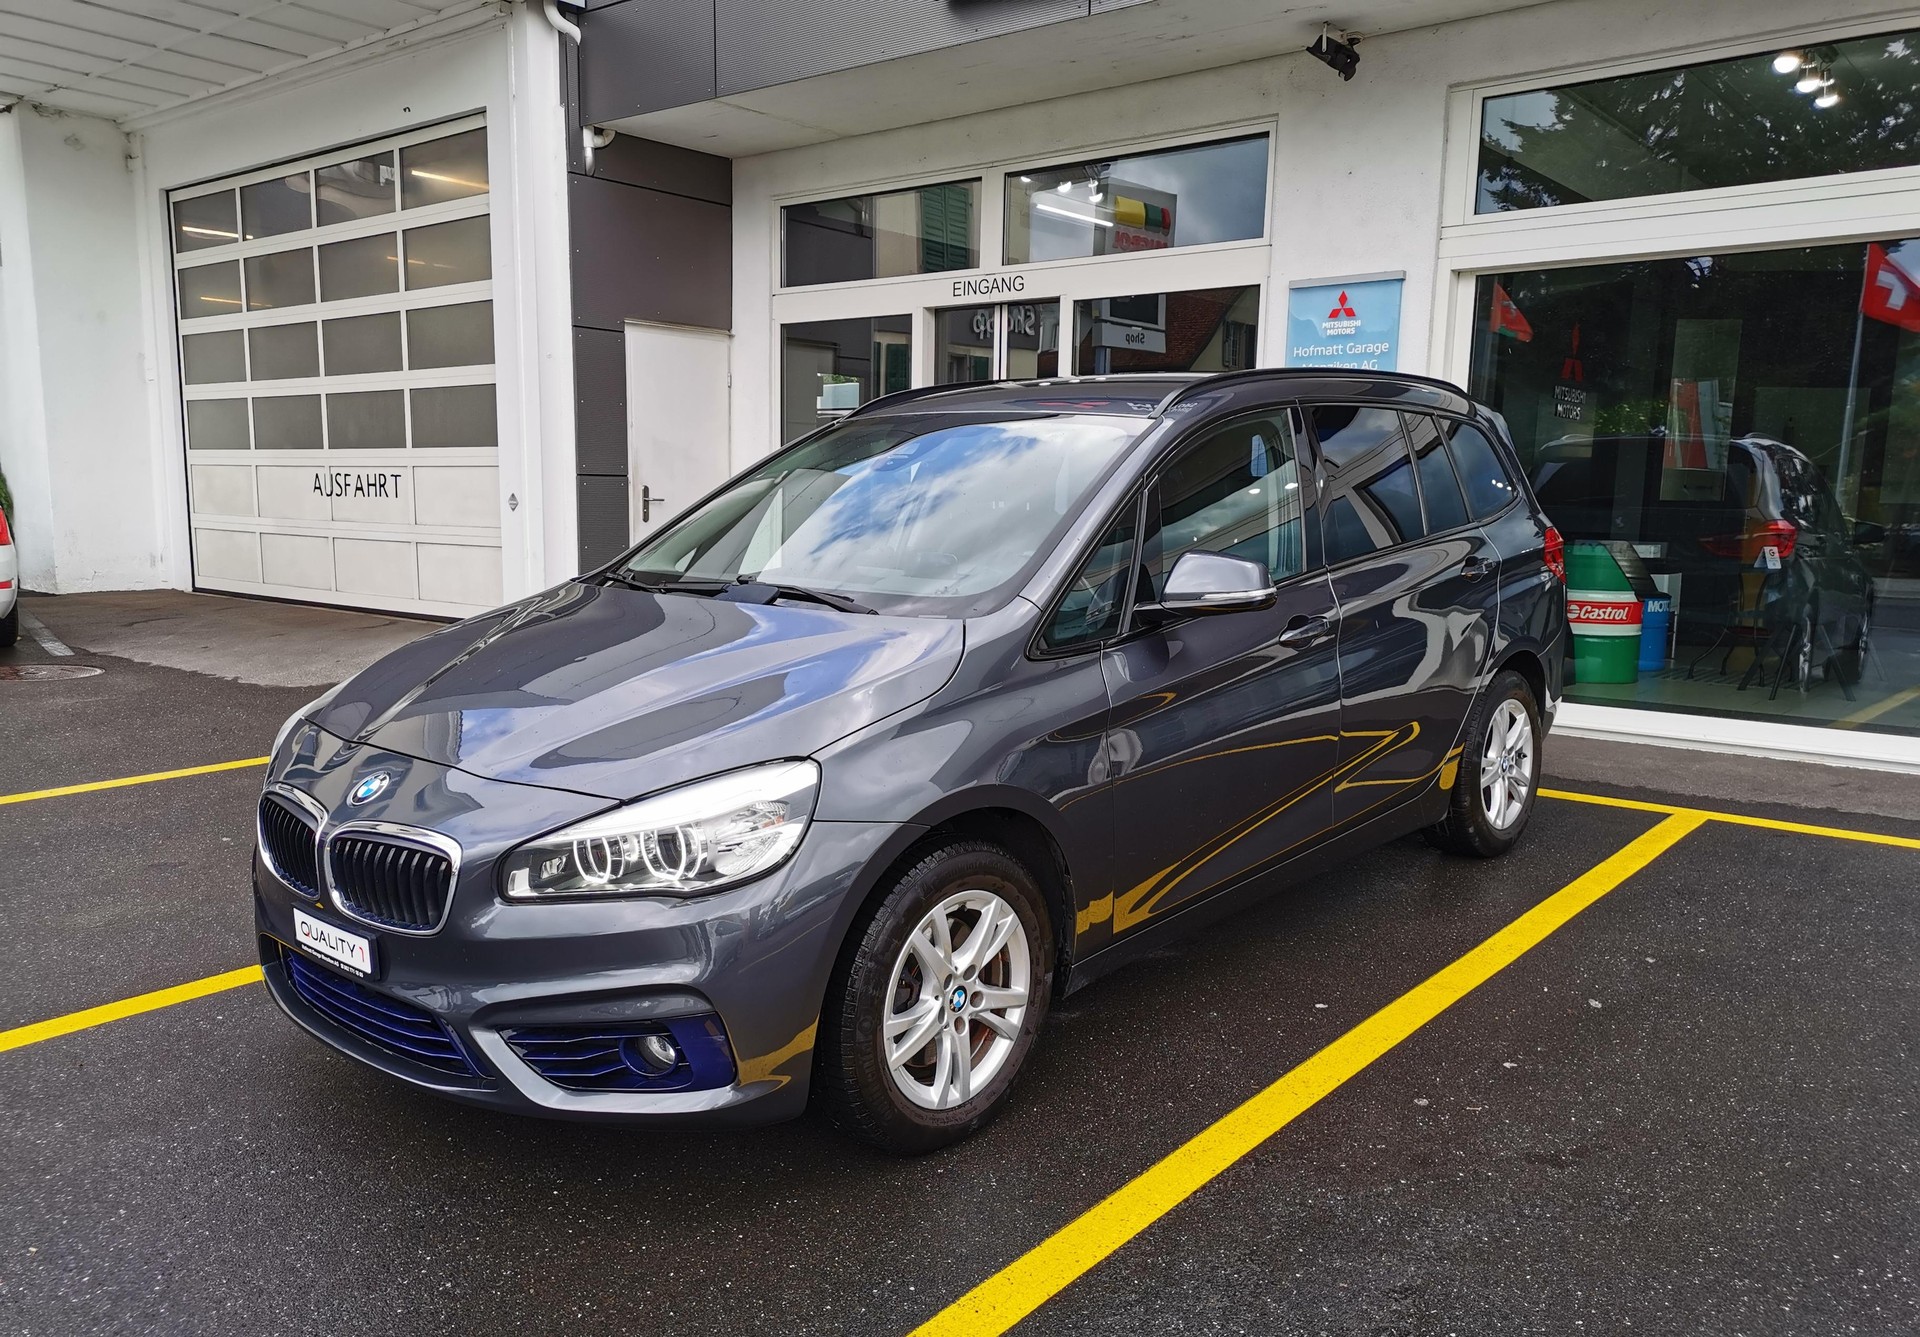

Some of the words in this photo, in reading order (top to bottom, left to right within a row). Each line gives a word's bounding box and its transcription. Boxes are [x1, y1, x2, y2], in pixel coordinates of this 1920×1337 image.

[952, 275, 1025, 297] EINGANG
[1322, 320, 1361, 329] MITSUBISHI
[1327, 328, 1355, 336] MOTORS
[1293, 344, 1344, 357] Hofmatt
[1346, 342, 1389, 355] Garage
[1361, 360, 1378, 370] AG
[1556, 403, 1581, 420] MOTORS
[313, 473, 402, 498] AUSFAHRT
[1579, 605, 1628, 620] Castrol
[301, 921, 356, 958] QUALITY
